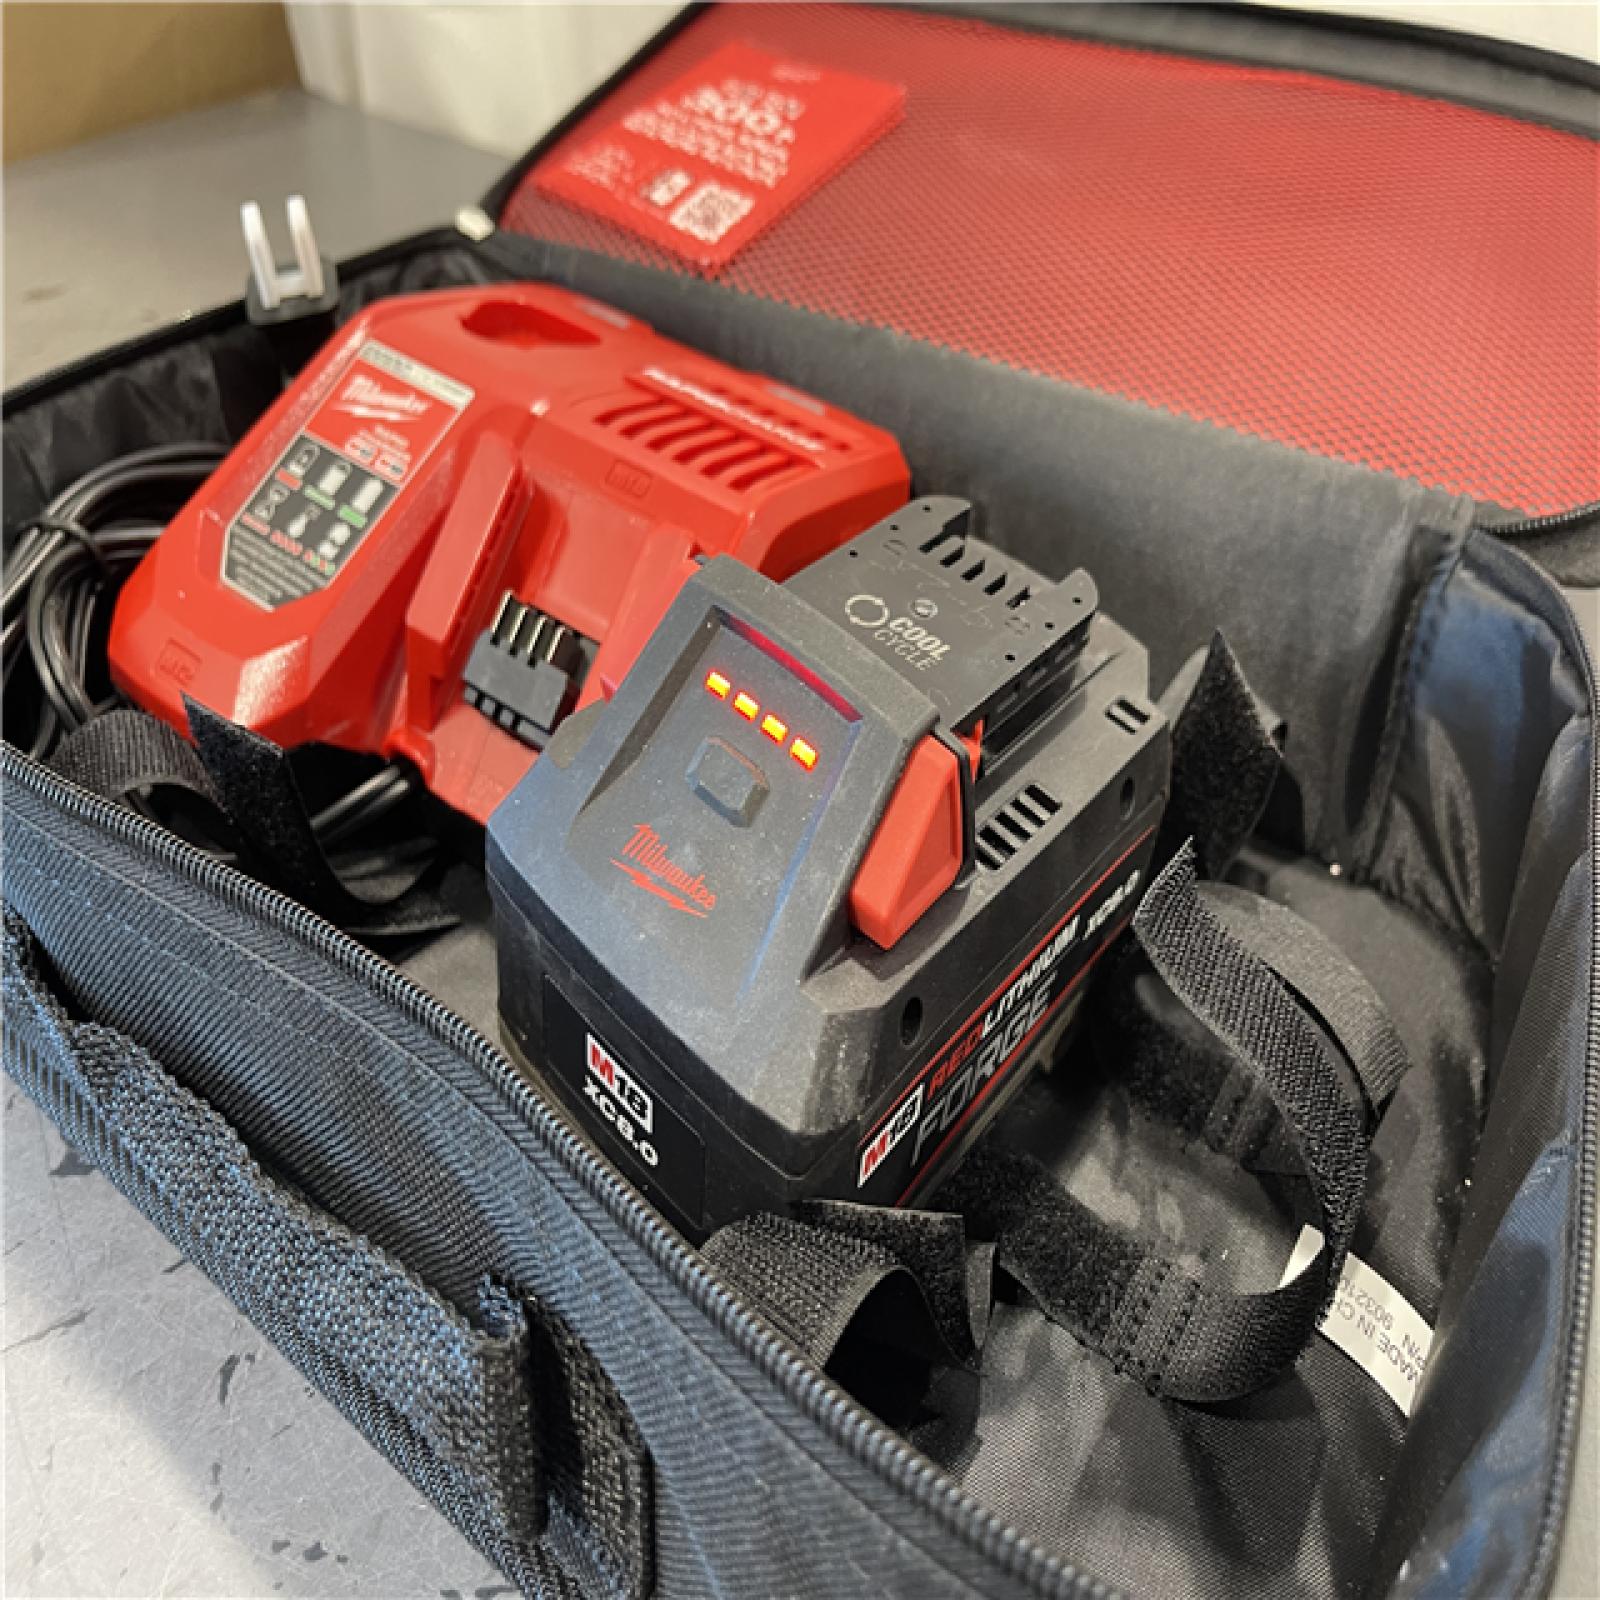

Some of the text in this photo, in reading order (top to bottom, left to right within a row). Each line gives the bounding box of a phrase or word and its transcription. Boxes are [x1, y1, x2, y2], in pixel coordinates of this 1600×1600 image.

[873, 629, 944, 671] CYCLE
[889, 617, 951, 661] COOL
[619, 824, 717, 912] Milwaukee
[588, 1040, 650, 1121] M18
[910, 969, 1058, 1168] FORGE
[582, 1075, 659, 1167] XC8.0
[859, 1090, 923, 1181] M18
[1357, 1314, 1376, 1339] IN
[1377, 1332, 1419, 1381] MADE
